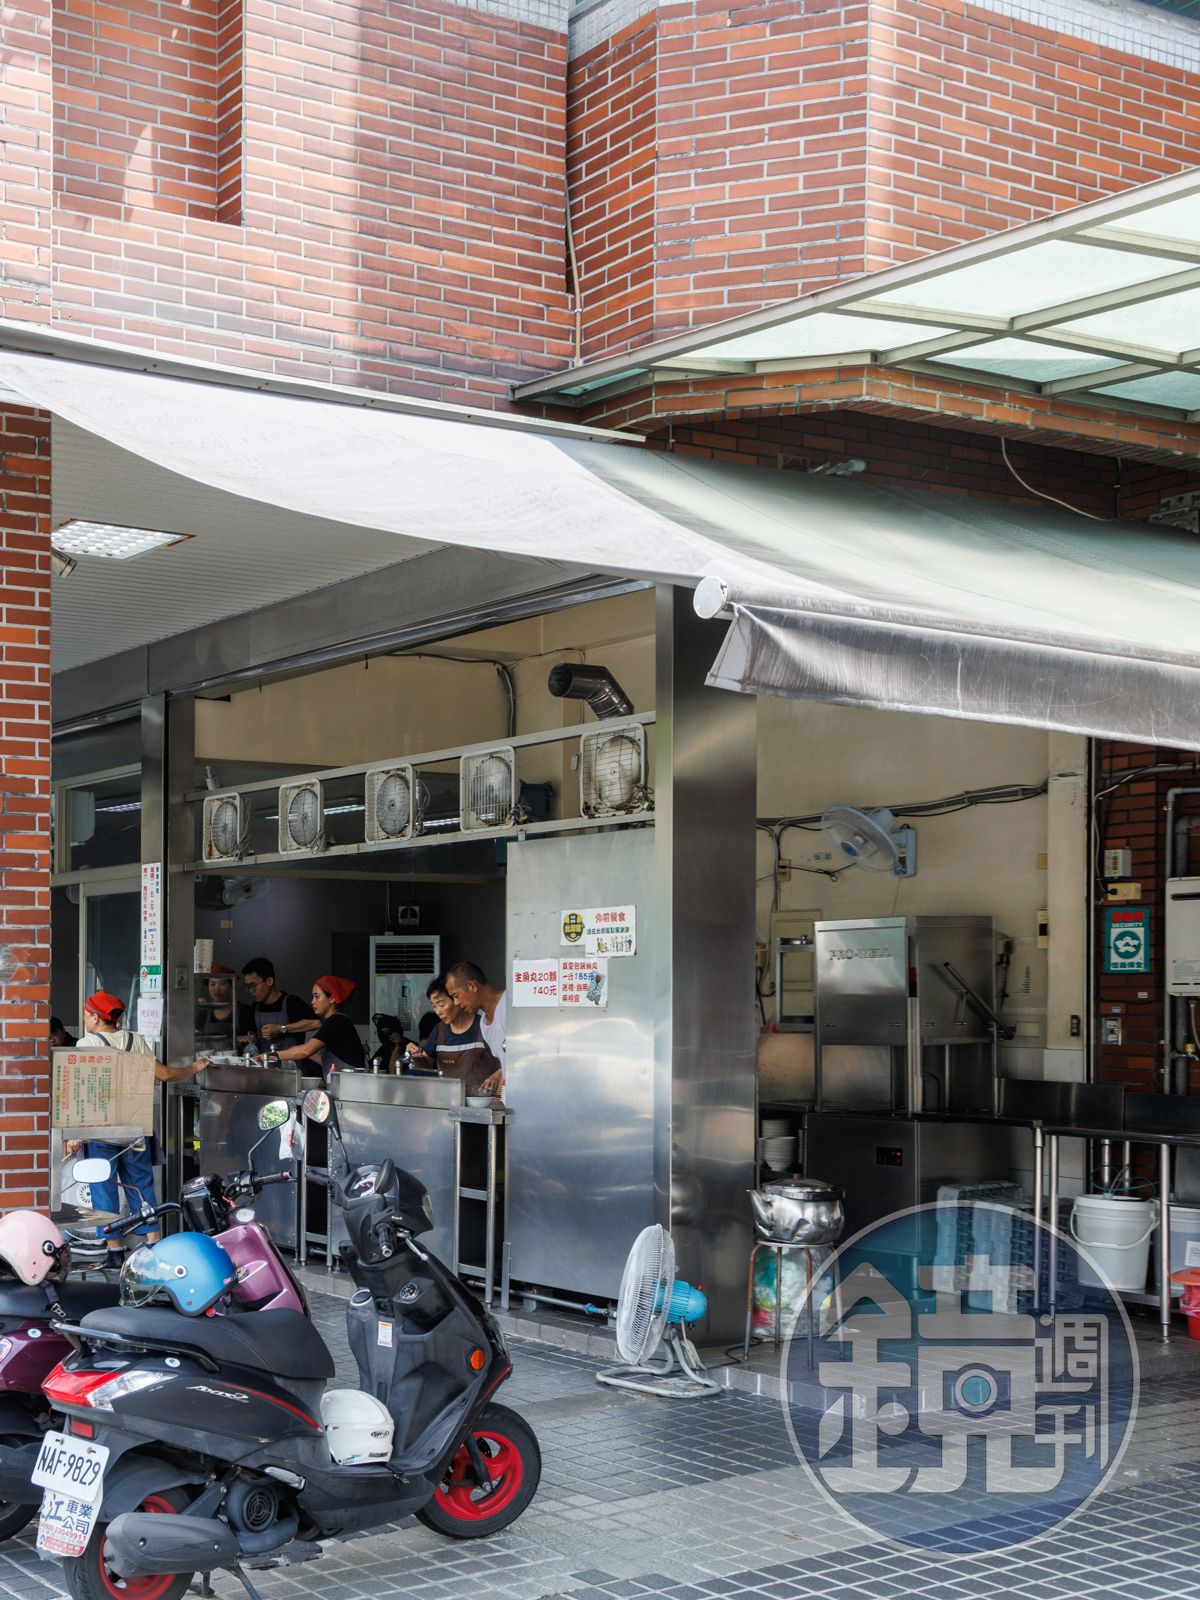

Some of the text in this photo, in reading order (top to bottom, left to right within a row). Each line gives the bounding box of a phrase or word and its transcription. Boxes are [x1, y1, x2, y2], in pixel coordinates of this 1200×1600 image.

[533, 985, 557, 996] 140元
[65, 1499, 94, 1520] 車業
[61, 1515, 90, 1536] 公司
